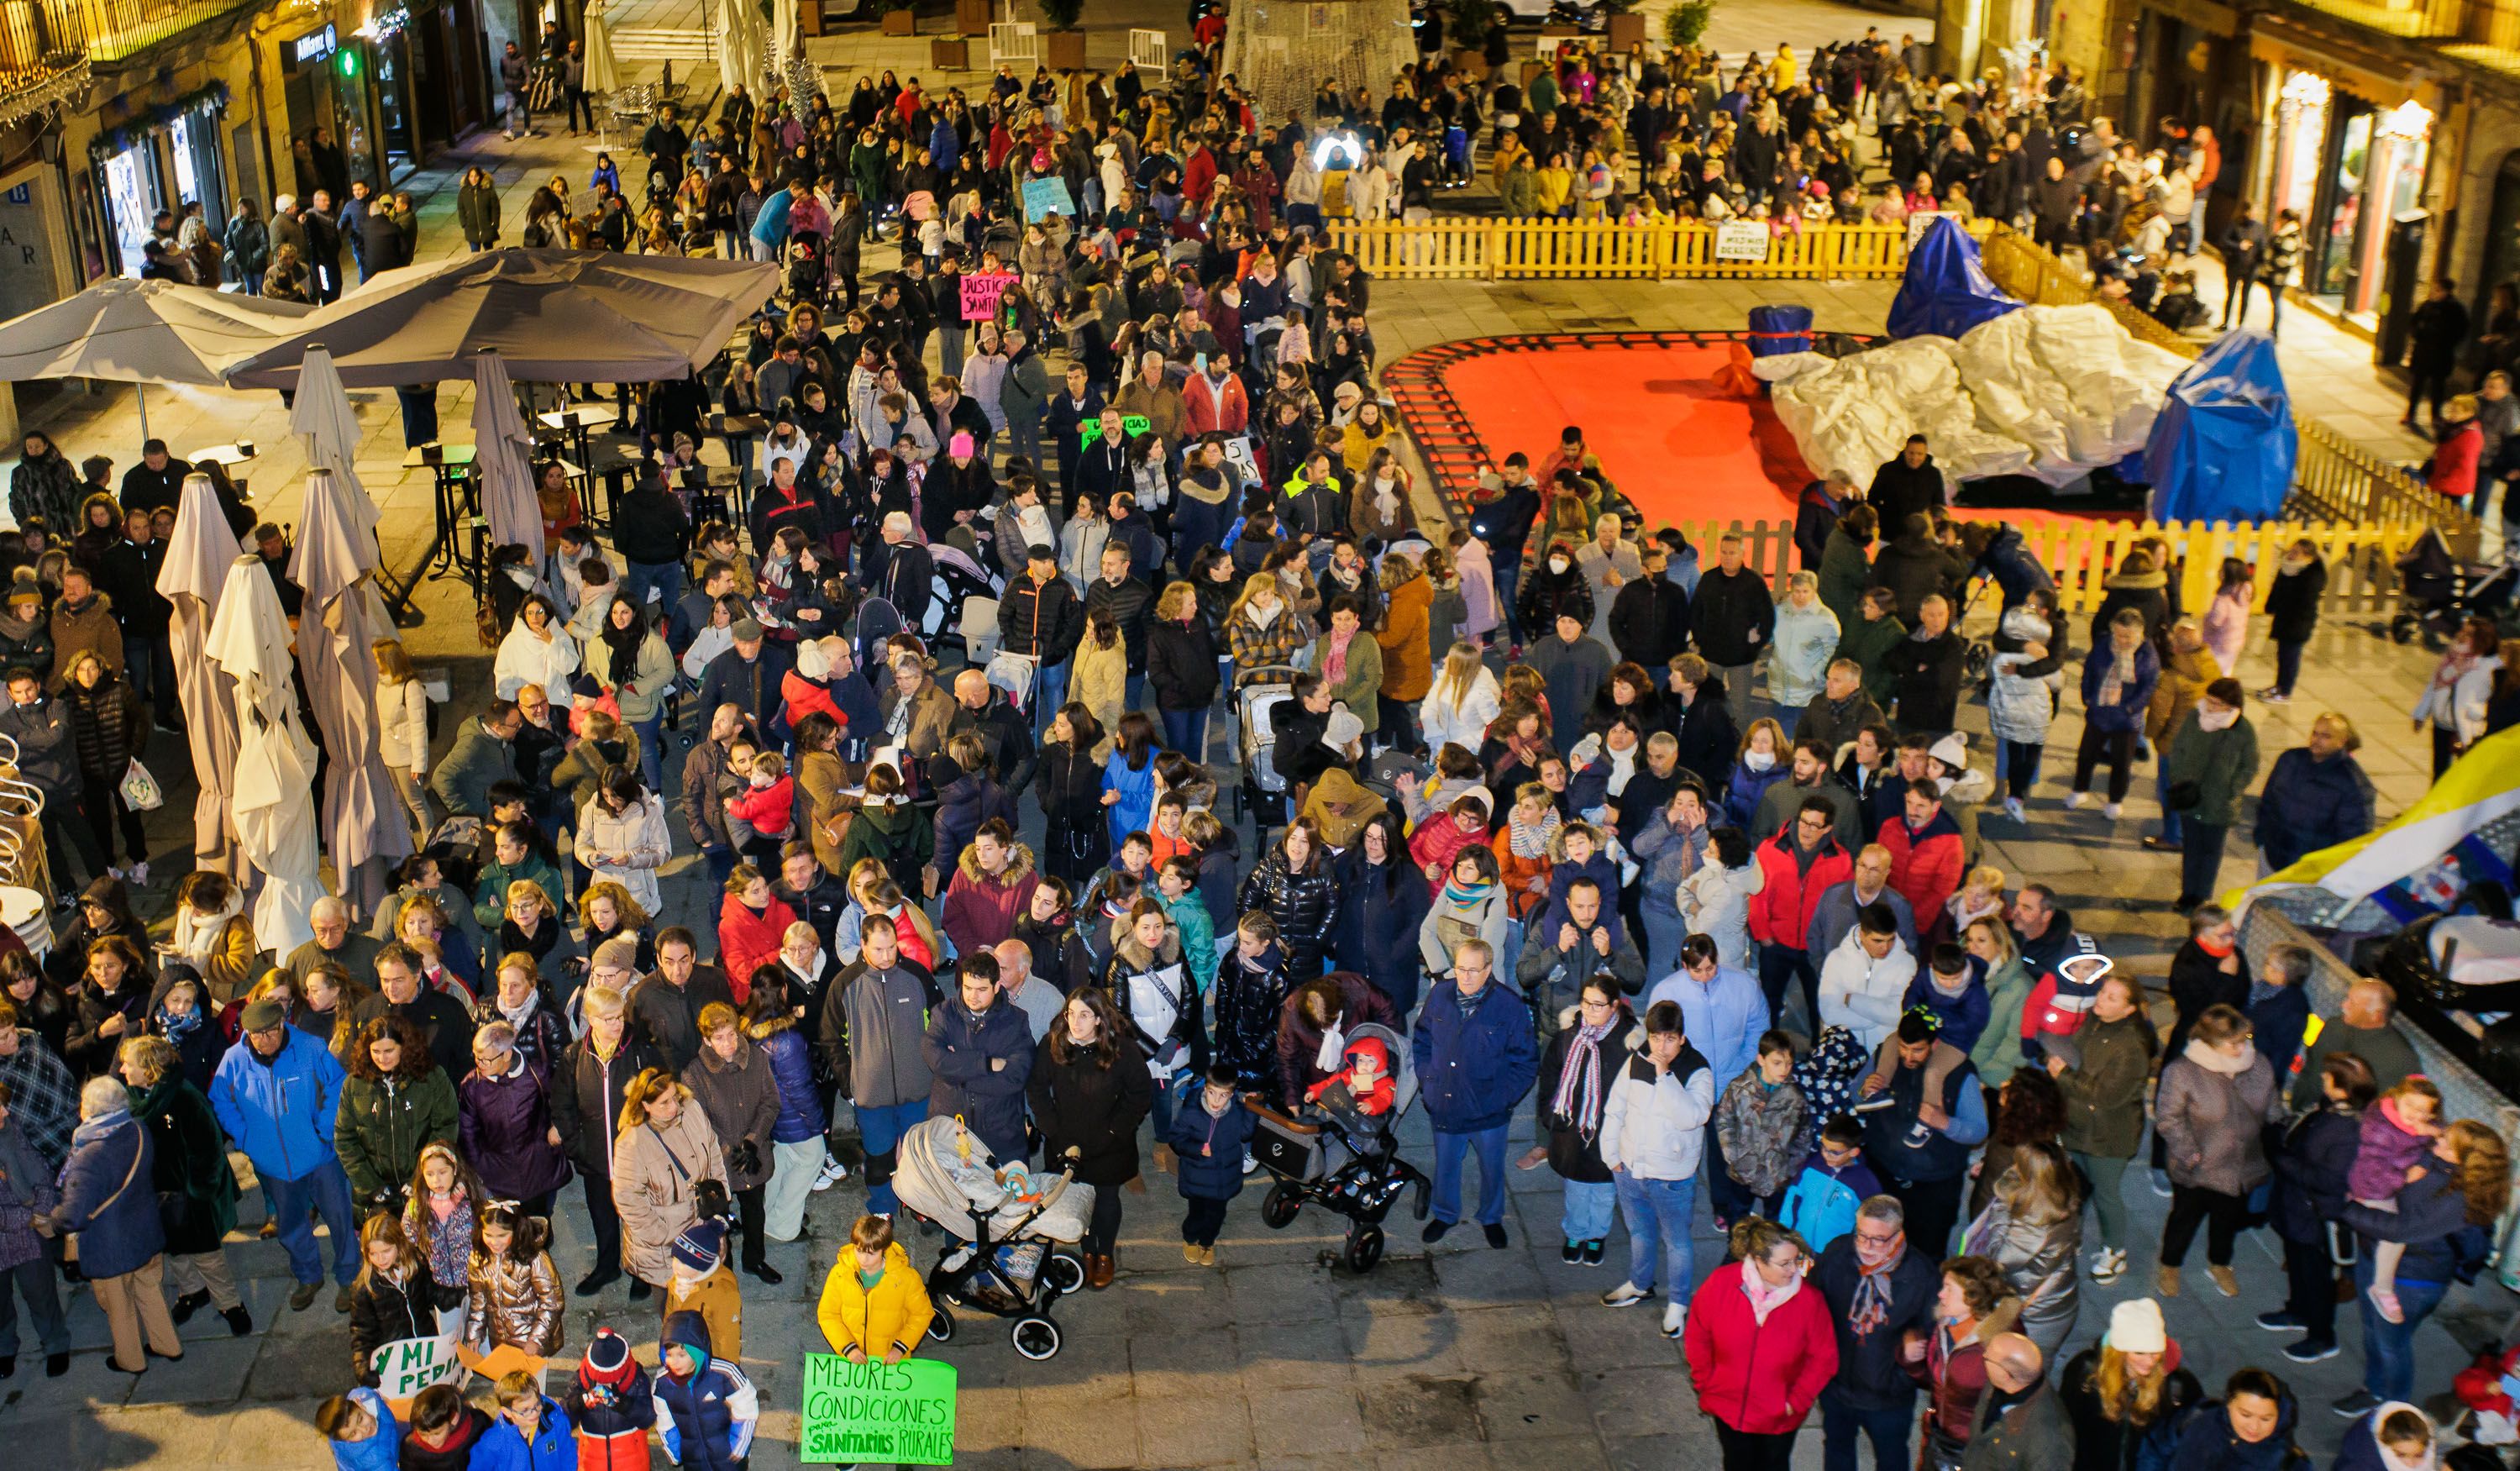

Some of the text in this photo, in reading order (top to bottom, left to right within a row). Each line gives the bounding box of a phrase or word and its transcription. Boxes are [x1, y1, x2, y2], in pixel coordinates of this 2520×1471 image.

[963, 277, 1015, 294] JUSTIC
[375, 1341, 435, 1375] Y MI
[813, 1356, 913, 1391] MEJORES
[808, 1391, 947, 1425] CONDICIONES
[899, 1428, 954, 1460] RURALES
